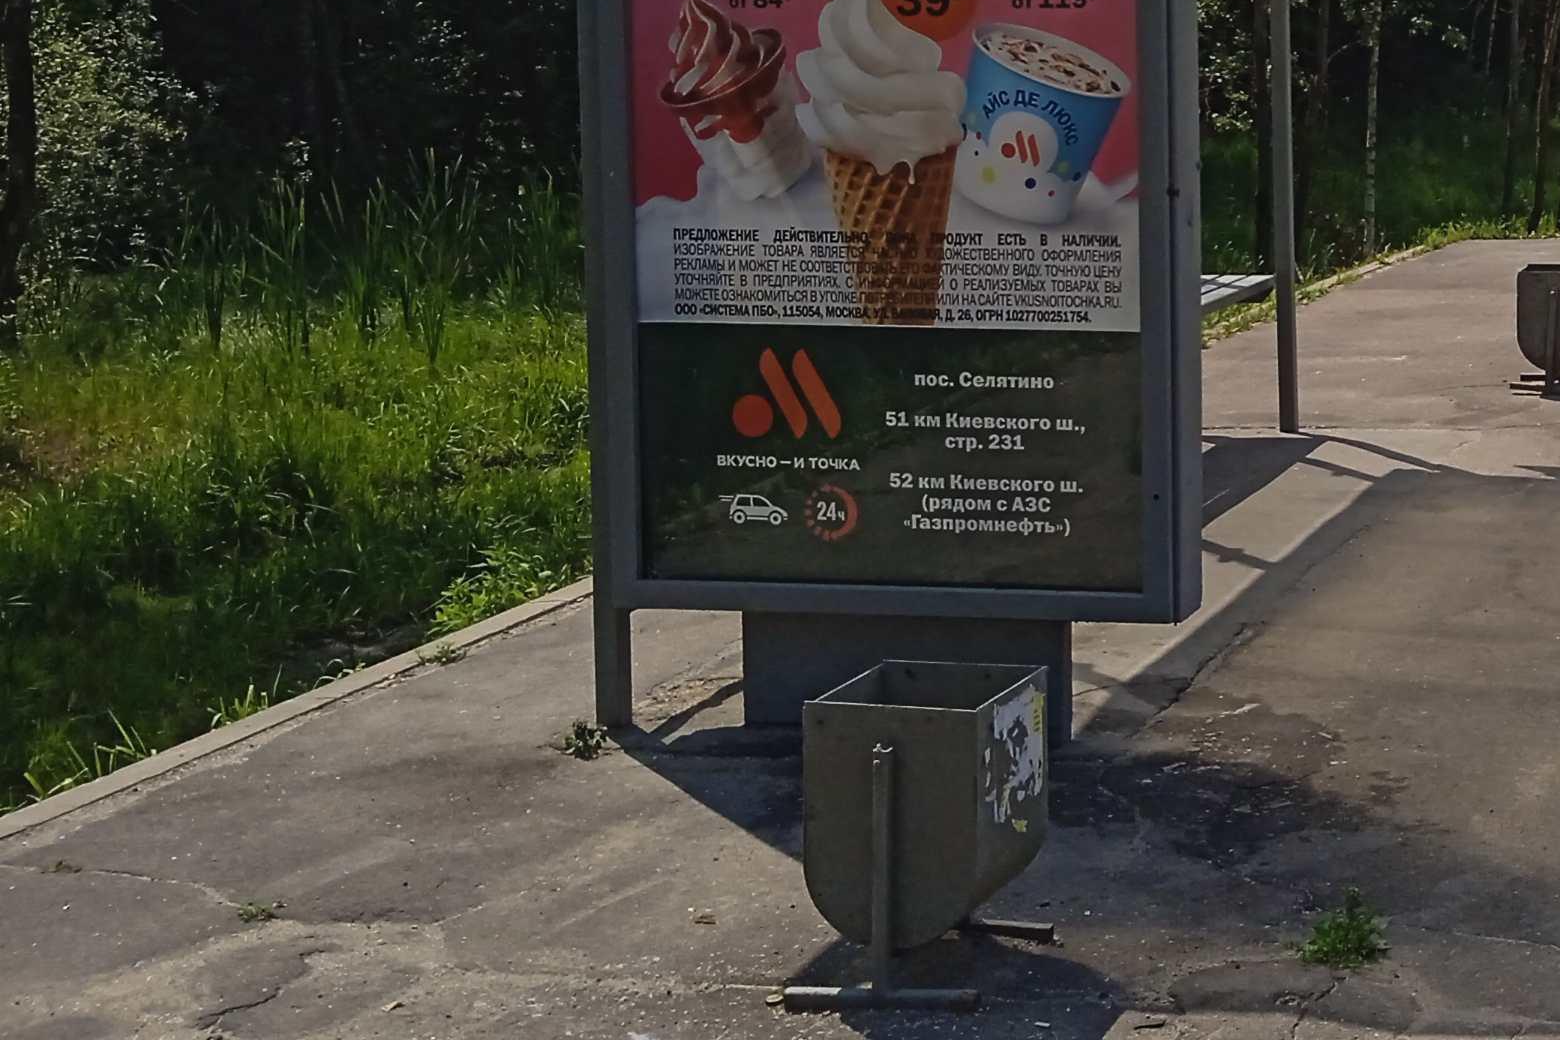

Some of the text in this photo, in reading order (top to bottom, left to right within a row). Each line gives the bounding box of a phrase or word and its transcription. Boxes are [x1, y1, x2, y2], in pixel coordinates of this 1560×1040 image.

[982, 89, 1079, 146] АЙС ДЕ ЛЮКС
[673, 228, 759, 242] ПРЕДЛОЖЕНИЕ
[998, 233, 1026, 246] ЕСТЬ
[1040, 234, 1048, 246] В
[1062, 234, 1122, 247] НАЛИЧИИ.
[674, 243, 755, 257] ИЗОБРАЖЕНИЕ
[762, 244, 805, 257] ТОВАРА
[810, 246, 864, 259] ЯВЛЯЕТСЯ
[1041, 249, 1121, 262] ОФОРМЛЕНИЯ
[674, 259, 725, 271] РЕКЛАМЫ
[728, 260, 735, 271] И
[738, 260, 780, 272] МОЖЕТ
[782, 261, 797, 272] НЕ
[1045, 265, 1091, 277] ТОЧНУЮ
[1093, 265, 1122, 278] ЦЕНУ
[674, 272, 735, 286] УТОЧНЯЙТЕ
[740, 275, 748, 286] В
[845, 277, 853, 288] С
[950, 278, 958, 291] О
[963, 279, 1046, 292] РЕАЛИЗУЕМЫХ
[1051, 280, 1100, 293] ТОВАРАХ
[1104, 281, 1122, 293] ВЫ
[674, 287, 720, 301] МОЖЕТЕ
[721, 289, 808, 302] ОЗНАКОМИТЬСЯ
[810, 291, 817, 302] В
[819, 291, 857, 304] УГОЛКЕ
[937, 293, 959, 305] ИЛИ
[962, 293, 976, 305] НА
[977, 292, 1012, 306] САЙТЕ
[675, 303, 697, 315] ООО
[783, 306, 823, 319] 115054,
[945, 309, 955, 321] Д.
[957, 309, 973, 321] 26,
[976, 310, 1003, 321] ОГРН
[914, 371, 1054, 389] пос. Селятино
[885, 411, 1086, 434] 51 км Киевского ш.,
[945, 434, 1025, 452] стр. 231
[716, 454, 777, 468] ВКУСНО
[794, 457, 804, 468] И
[808, 457, 860, 471] ТОЧКА
[889, 473, 1084, 493] 52 км Киевского ш.
[921, 493, 1051, 512] (рядом с АЗС
[903, 514, 1071, 537] «Газпромнефть»)
